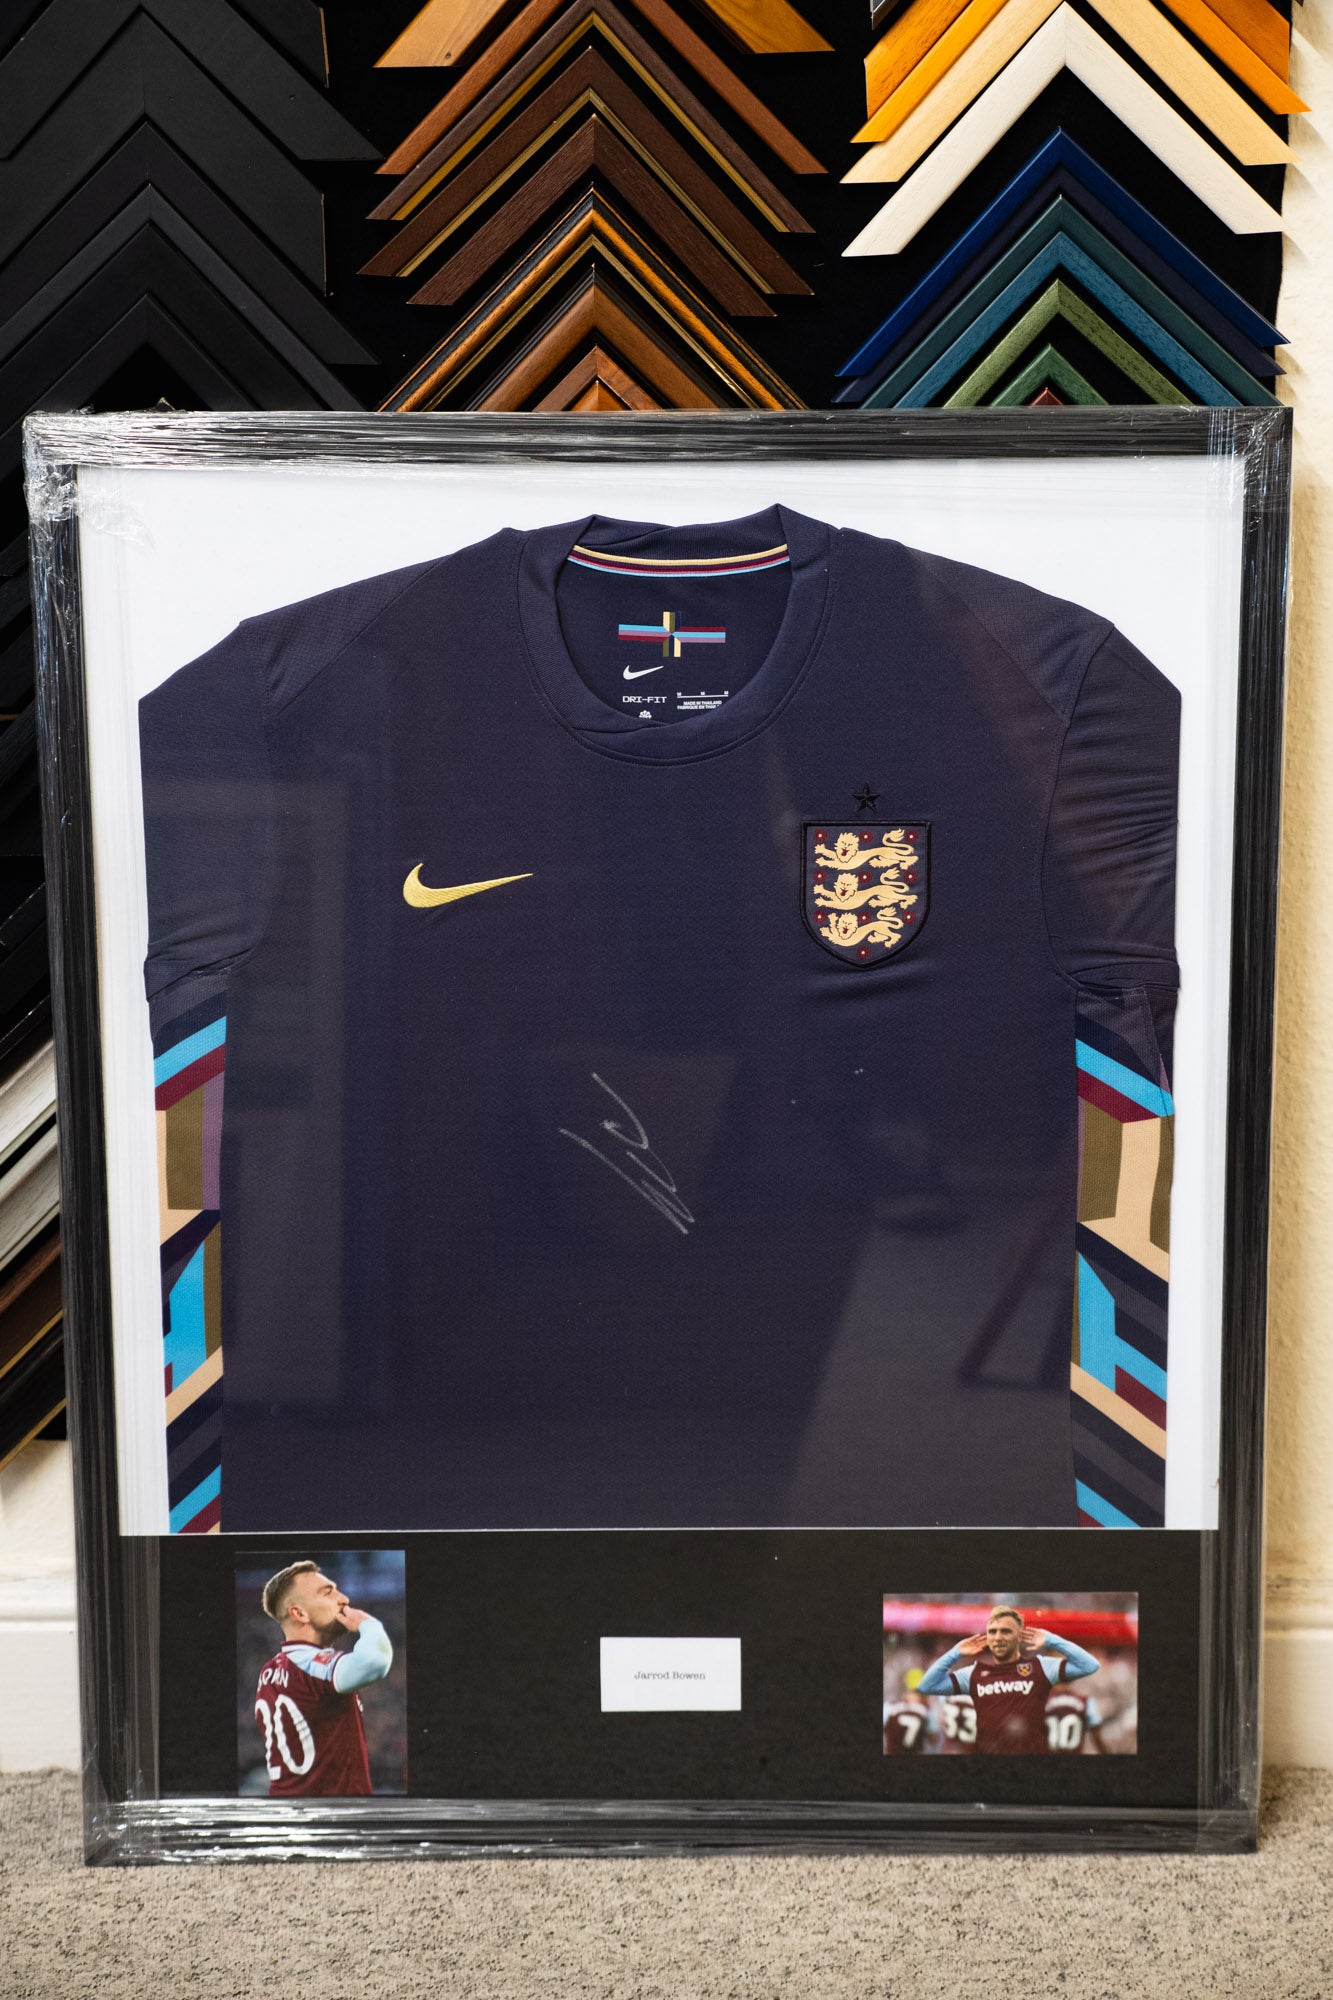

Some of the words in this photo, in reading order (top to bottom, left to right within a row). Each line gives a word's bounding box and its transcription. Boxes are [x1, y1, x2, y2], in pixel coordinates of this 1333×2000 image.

[622, 695, 667, 703] DRI-FIT
[634, 1671, 670, 1680] Jarrod
[672, 1671, 706, 1680] Bowen
[977, 1680, 1034, 1697] betway
[255, 1693, 316, 1781] 20
[898, 1713, 922, 1748] 7
[1046, 1714, 1082, 1750] 10
